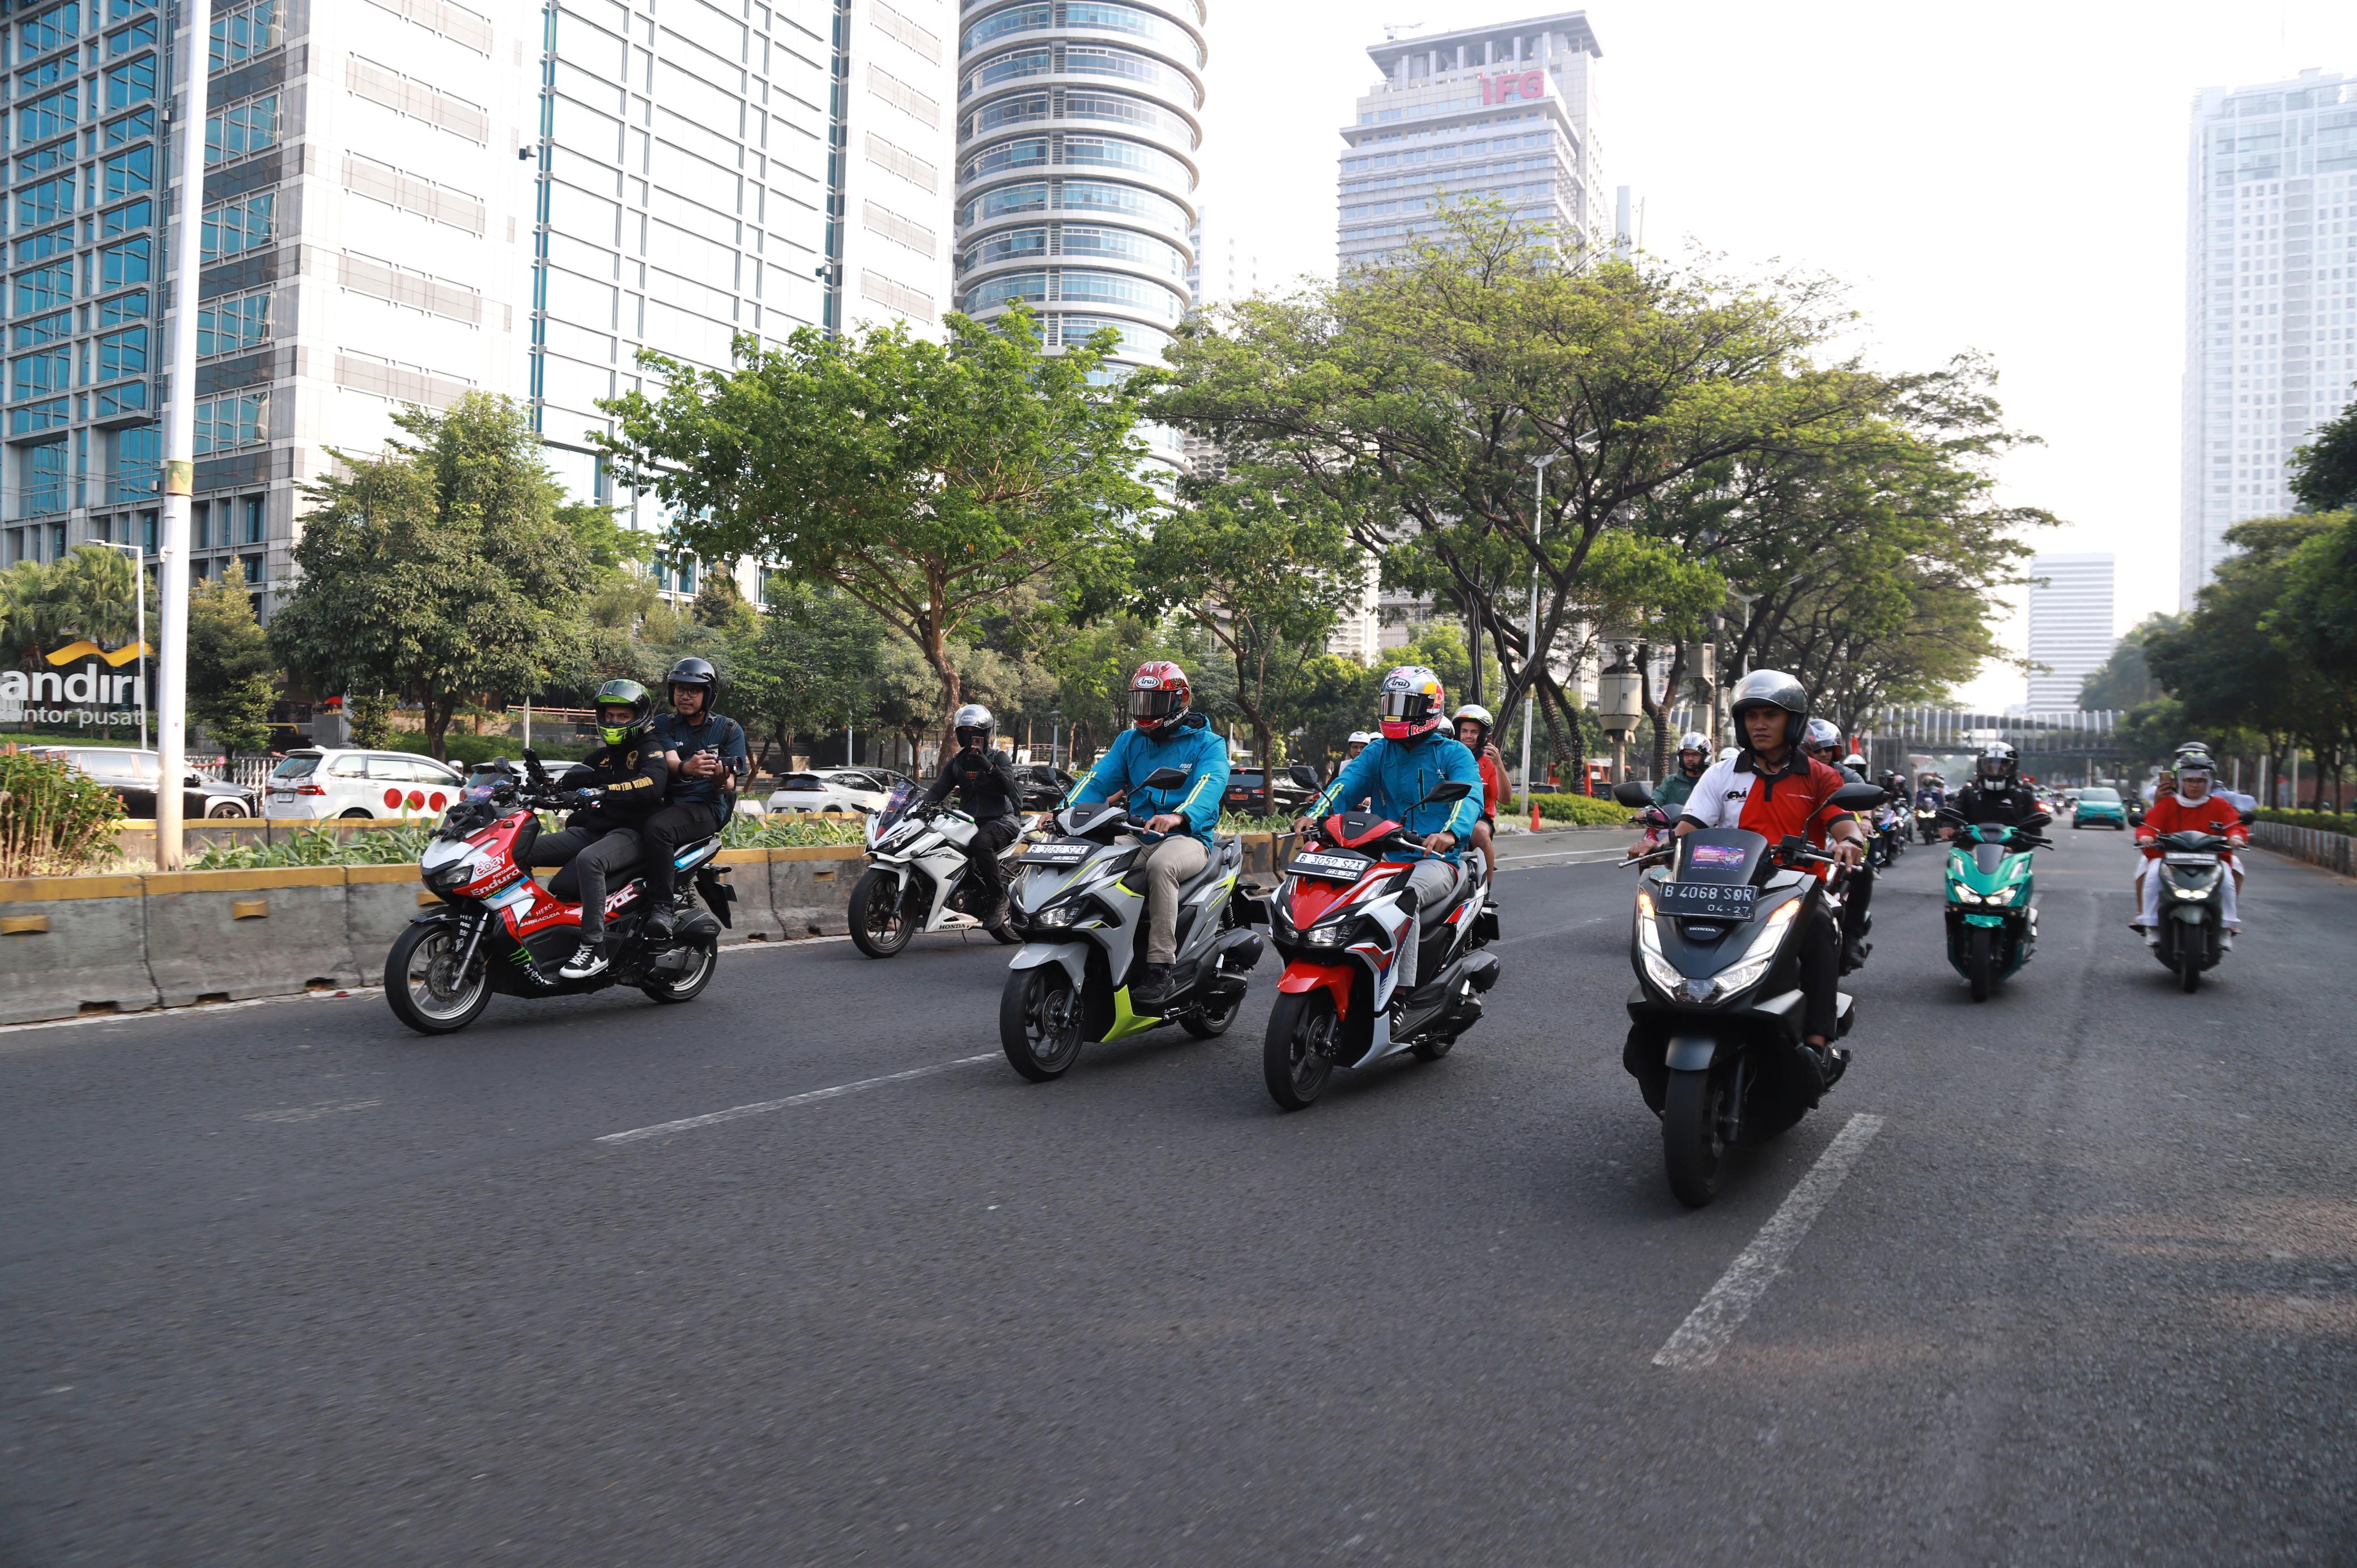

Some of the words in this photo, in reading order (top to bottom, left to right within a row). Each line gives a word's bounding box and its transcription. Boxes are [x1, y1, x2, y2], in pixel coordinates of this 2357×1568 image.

[1065, 846, 1086, 855] SZX
[475, 851, 505, 877] ebay
[1311, 856, 1338, 866] 3059
[1341, 860, 1363, 870] SZX
[470, 868, 520, 896] Enduro
[1665, 885, 1674, 898] B
[1679, 886, 1718, 900] 4068
[535, 903, 553, 917] HERO
[520, 911, 560, 927] BARRACUDA
